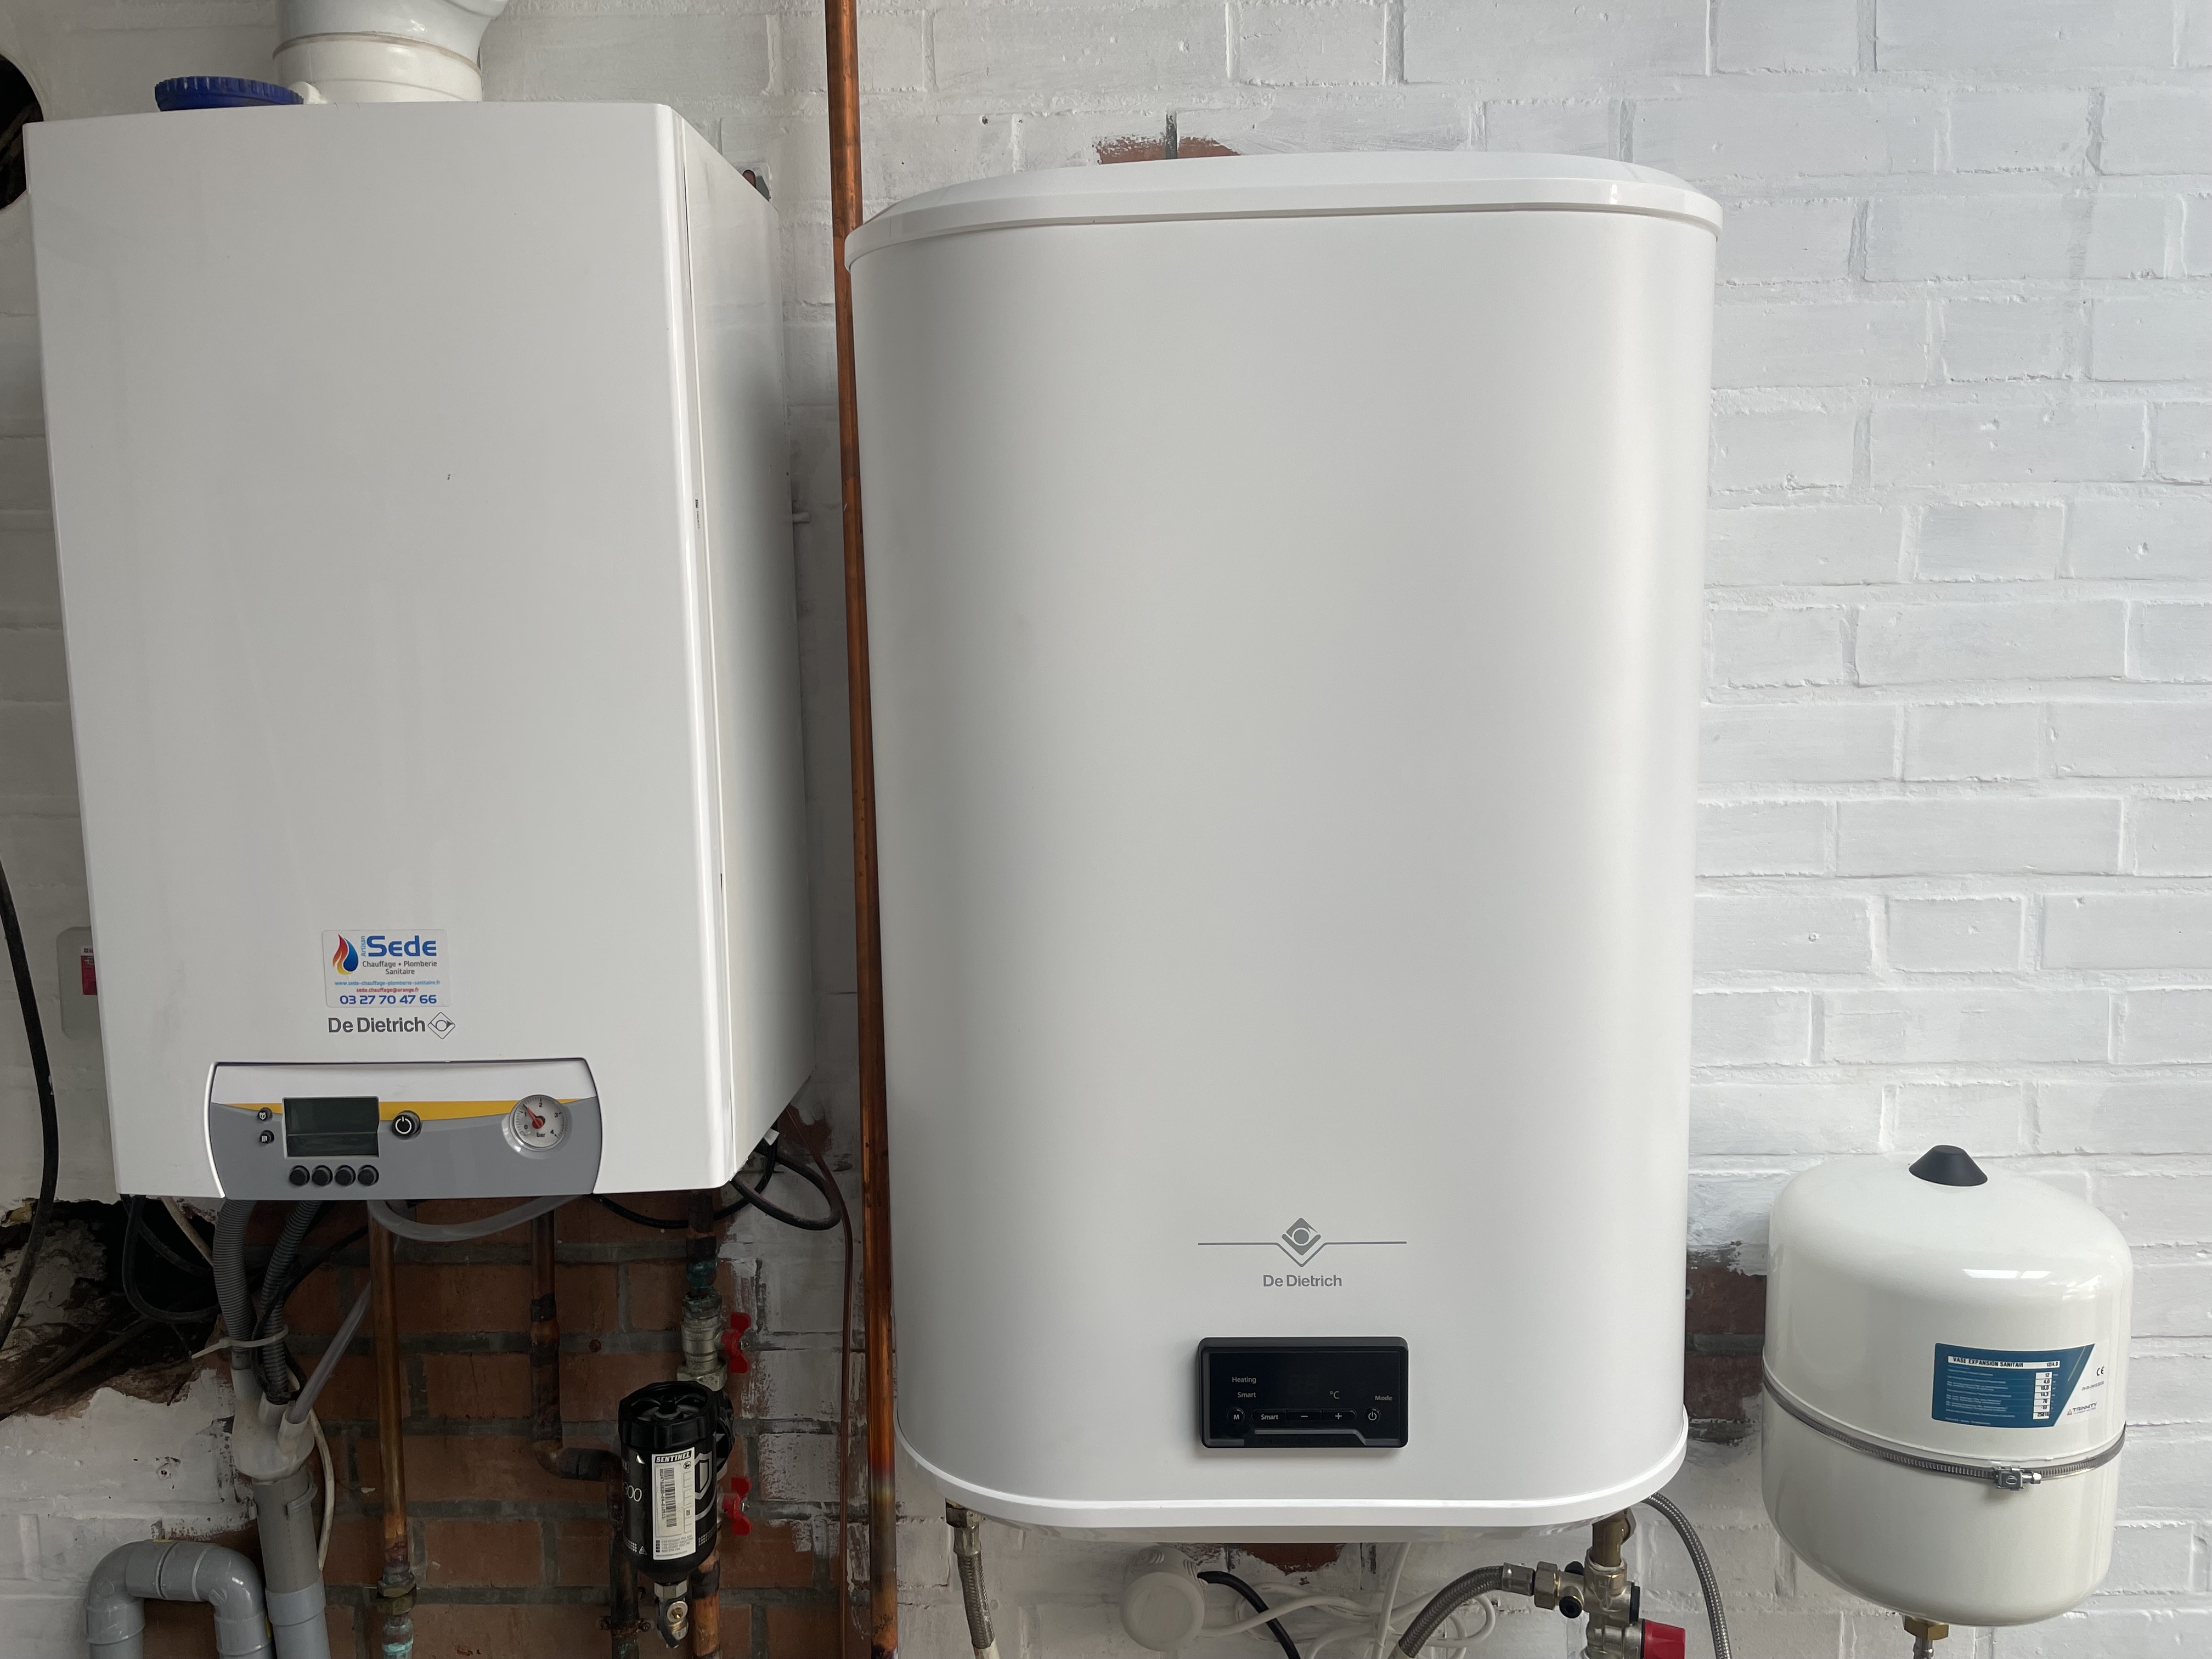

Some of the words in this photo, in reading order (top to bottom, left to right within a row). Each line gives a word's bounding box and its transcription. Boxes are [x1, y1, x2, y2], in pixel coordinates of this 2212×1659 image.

[366, 935, 437, 957] Sede
[340, 996, 356, 1005] 03
[360, 996, 376, 1005] 27
[379, 995, 396, 1005] 70
[399, 995, 416, 1004] 47
[419, 995, 437, 1004] 66
[329, 1018, 353, 1033] De
[357, 1017, 426, 1032] Dietrich
[1263, 1274, 1284, 1286] De
[1286, 1274, 1342, 1286] Dietrich
[1330, 1391, 1340, 1400] °C
[656, 1452, 690, 1463] SENTINEL
